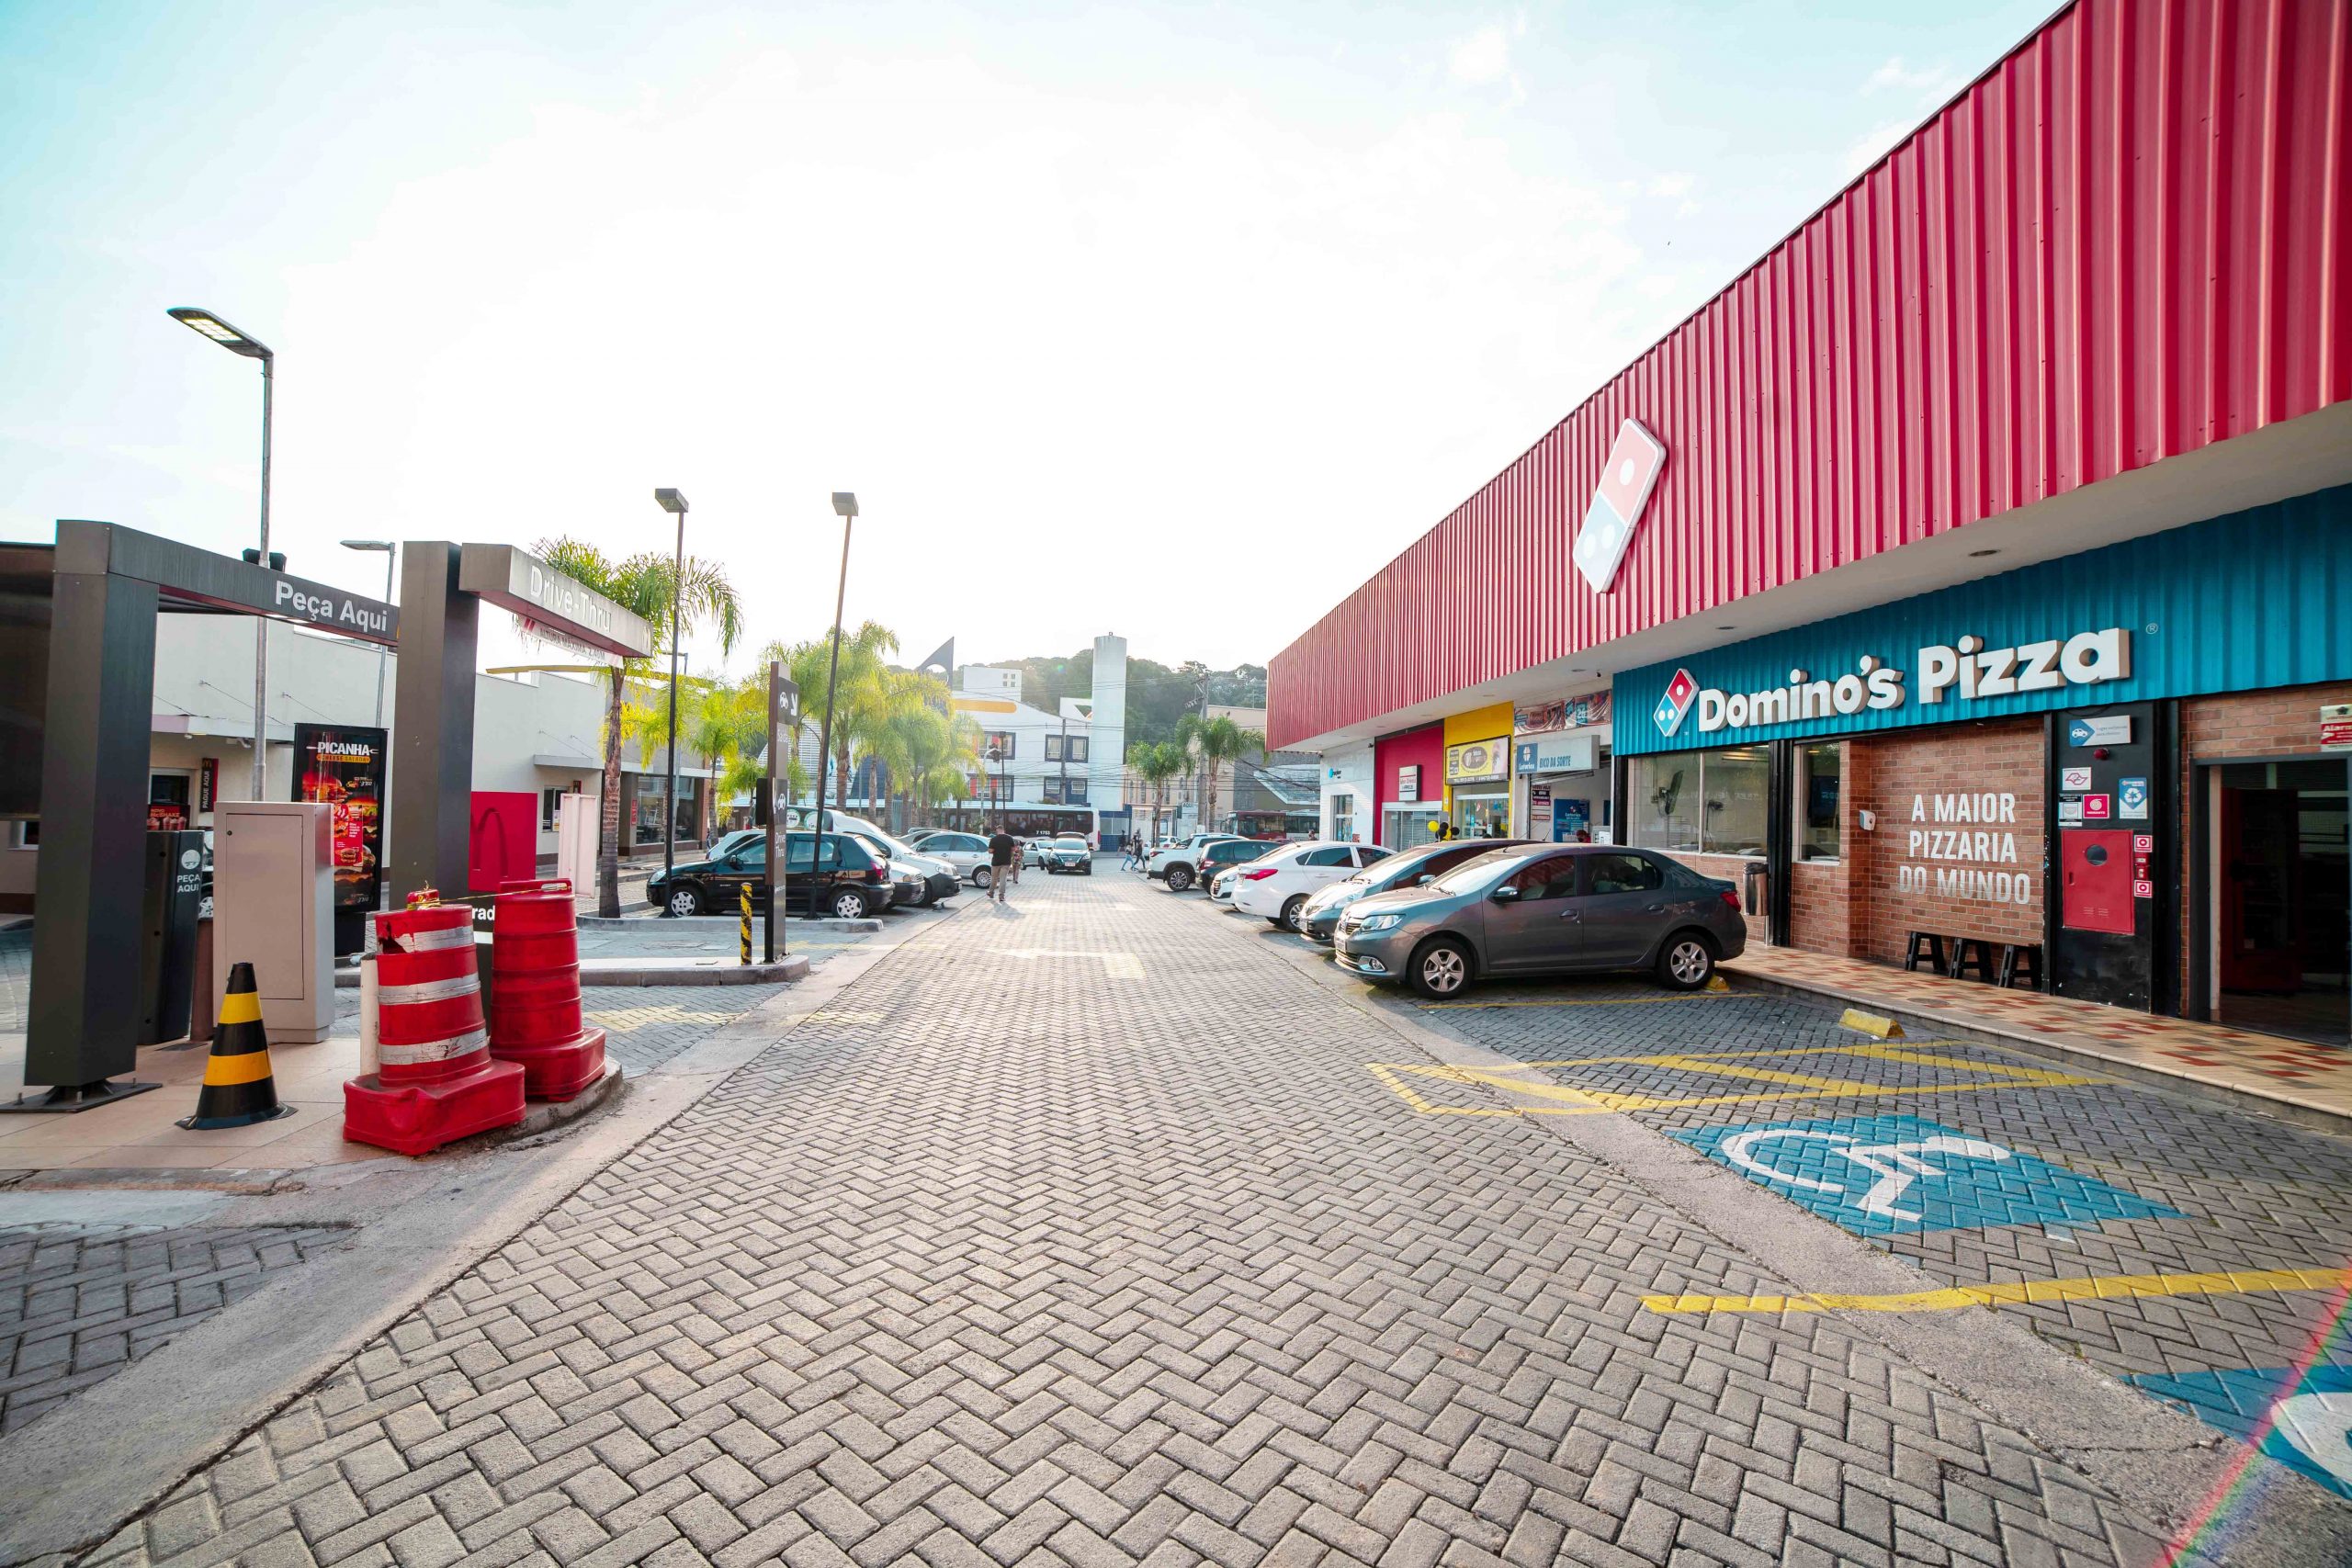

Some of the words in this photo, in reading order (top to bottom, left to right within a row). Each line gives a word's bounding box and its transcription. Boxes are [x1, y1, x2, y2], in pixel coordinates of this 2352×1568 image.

[276, 580, 333, 621] Peça
[339, 600, 388, 632] Aqui
[530, 565, 612, 633] Drive-Thru
[1699, 654, 1905, 732] Domino's
[1918, 627, 2131, 705] Pizza
[317, 741, 369, 756] PICANHA
[1539, 758, 1549, 768] RICO
[1550, 757, 1556, 767] DA
[1556, 755, 1571, 767] SORTE
[1911, 794, 1926, 822] A
[1934, 793, 2016, 823] MAIOR
[1909, 830, 2018, 863] PIZZARIA
[176, 874, 200, 884] PEÇA
[176, 884, 199, 893] AQUI
[1899, 865, 1927, 895] DO
[1937, 868, 2030, 905] MUNDO
